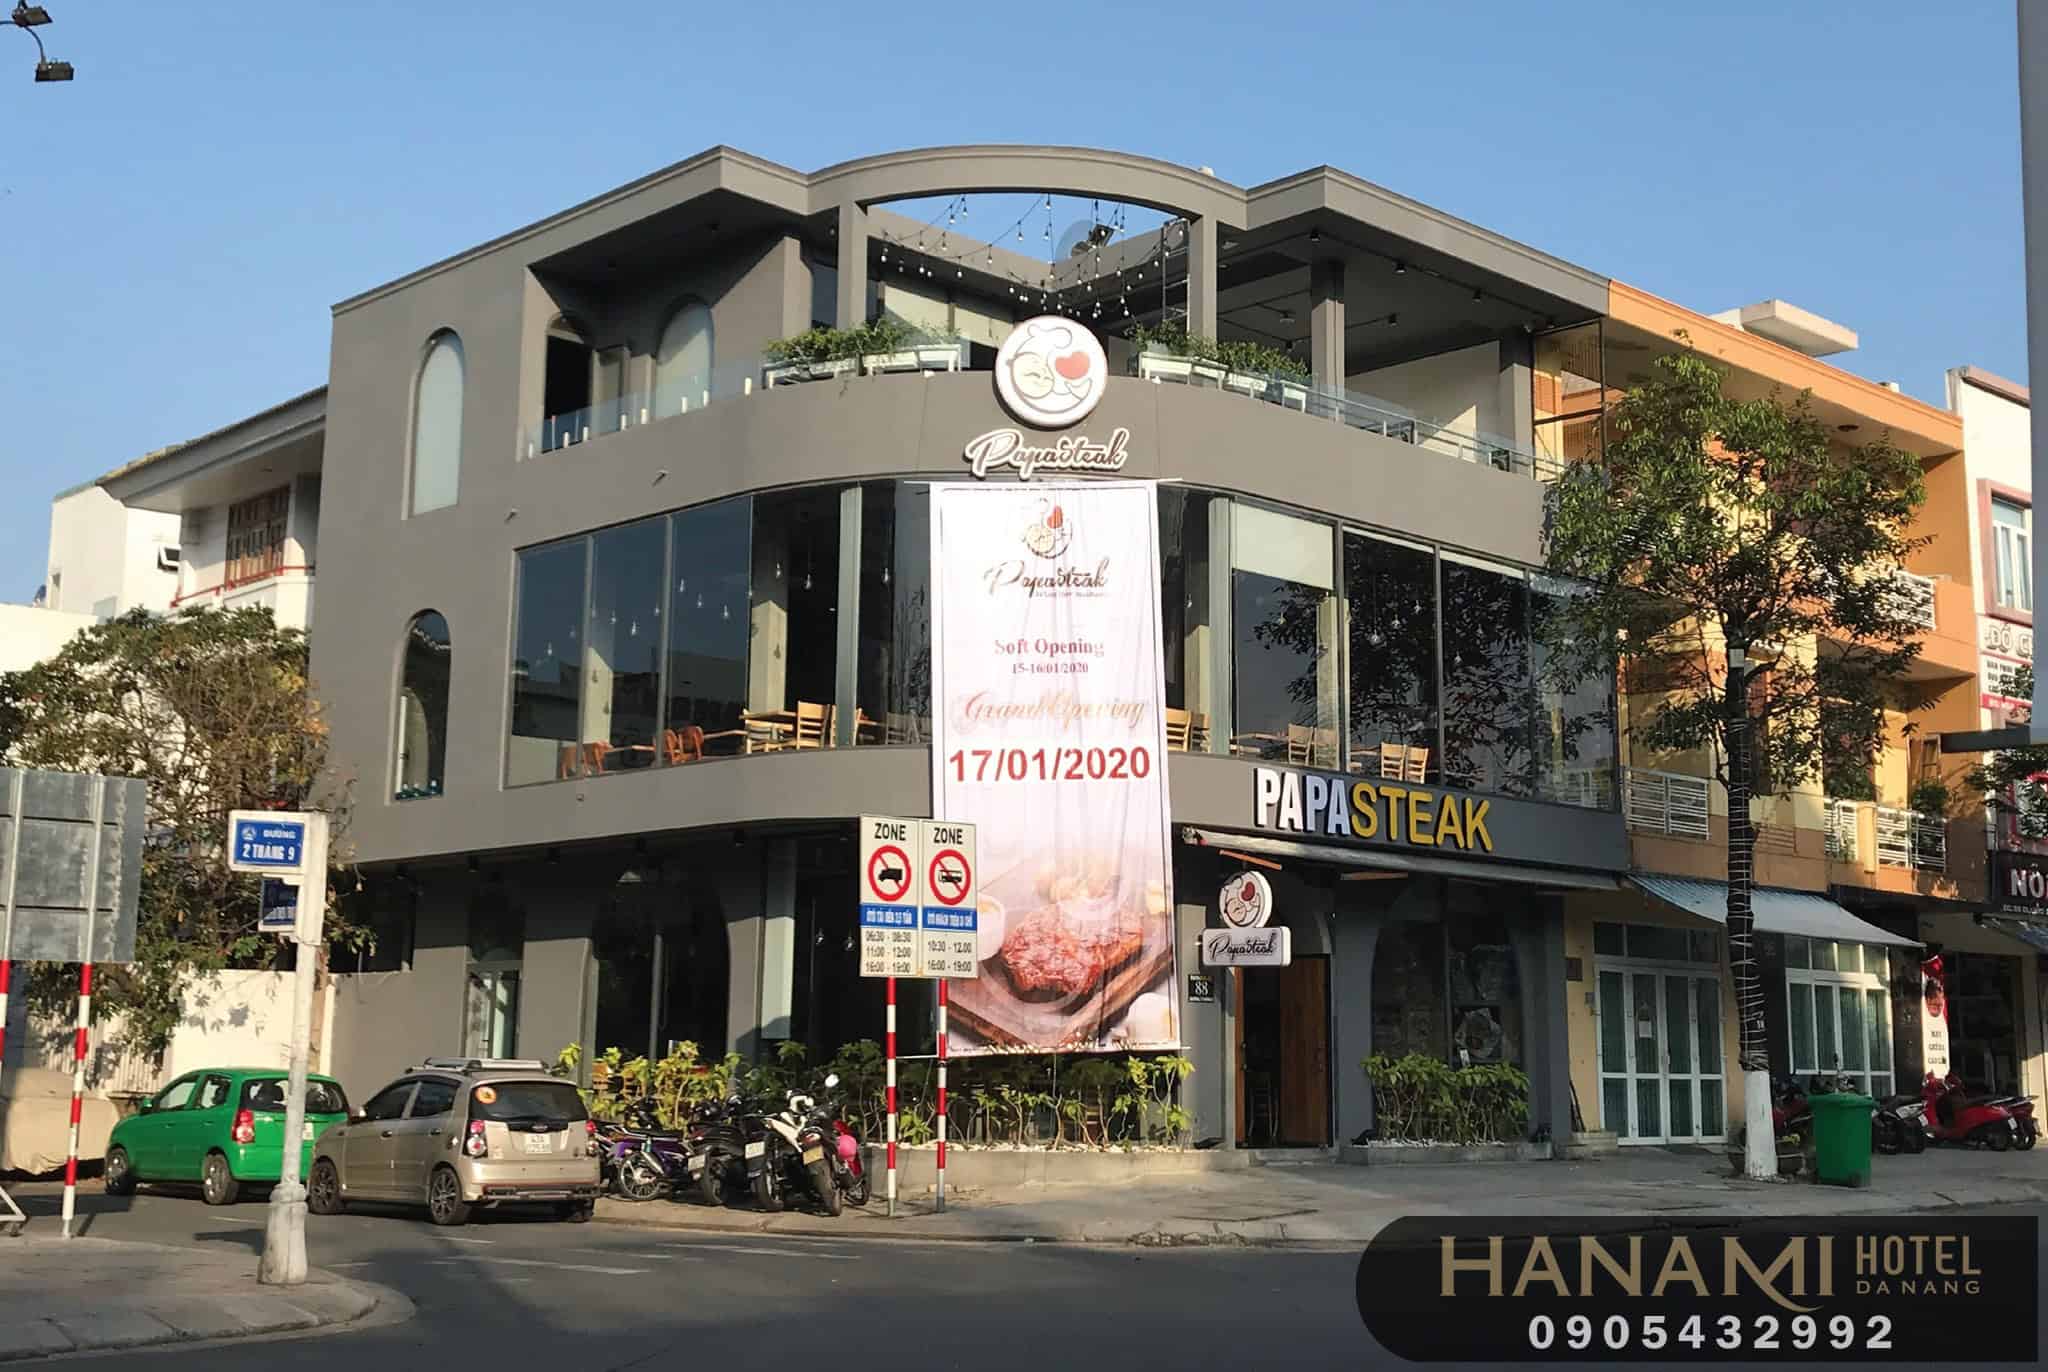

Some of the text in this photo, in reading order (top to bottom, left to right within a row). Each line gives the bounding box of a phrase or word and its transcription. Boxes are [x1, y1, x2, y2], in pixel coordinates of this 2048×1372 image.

[994, 638, 1105, 658] Soft Opening
[1012, 662, 1089, 674] 15-16/01/2020
[954, 690, 1146, 734] Grand Opening
[950, 747, 1150, 782] 17/01/2020
[1253, 767, 1494, 852] PAPASTEAK
[874, 823, 907, 841] ZONE
[933, 827, 963, 845] ZONE
[242, 843, 250, 858] 2
[287, 846, 295, 861] 9
[1195, 981, 1209, 996] 88
